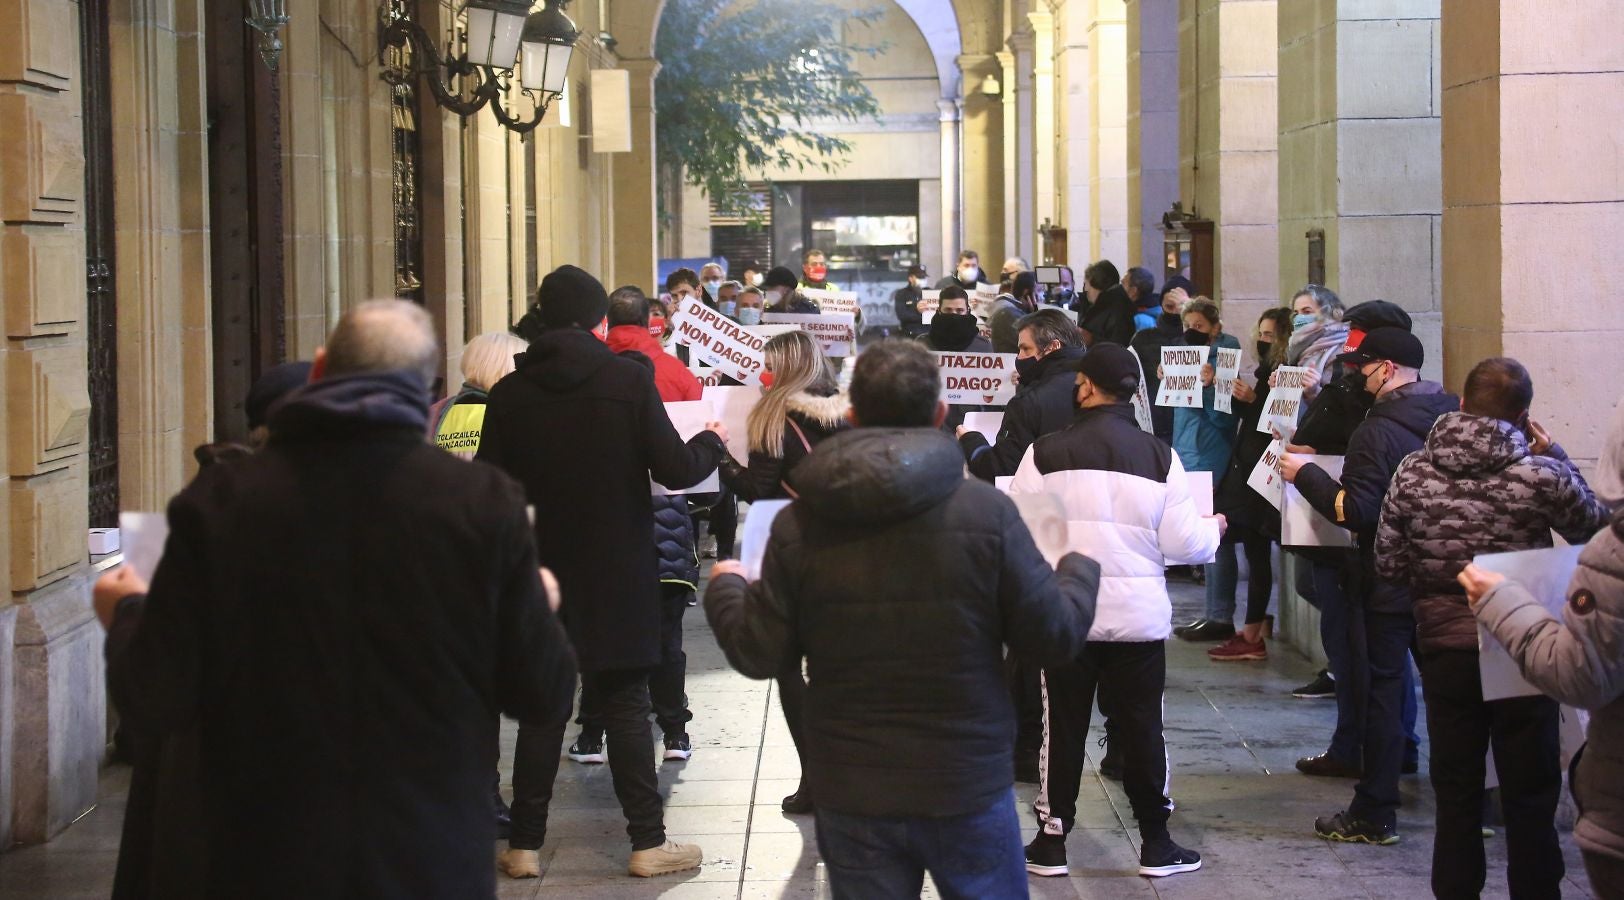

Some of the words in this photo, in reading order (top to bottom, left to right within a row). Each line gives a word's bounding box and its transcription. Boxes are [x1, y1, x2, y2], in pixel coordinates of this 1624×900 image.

[688, 303, 763, 353] DIPUTAZIO
[807, 323, 850, 331] SEGUNDA
[678, 320, 712, 347] NON
[711, 340, 761, 373] DAGO?
[1163, 350, 1201, 366] DIPUTAZIOA
[946, 376, 1002, 391] DAGO?
[1164, 375, 1179, 391] NON
[1178, 375, 1197, 391] DAGO?
